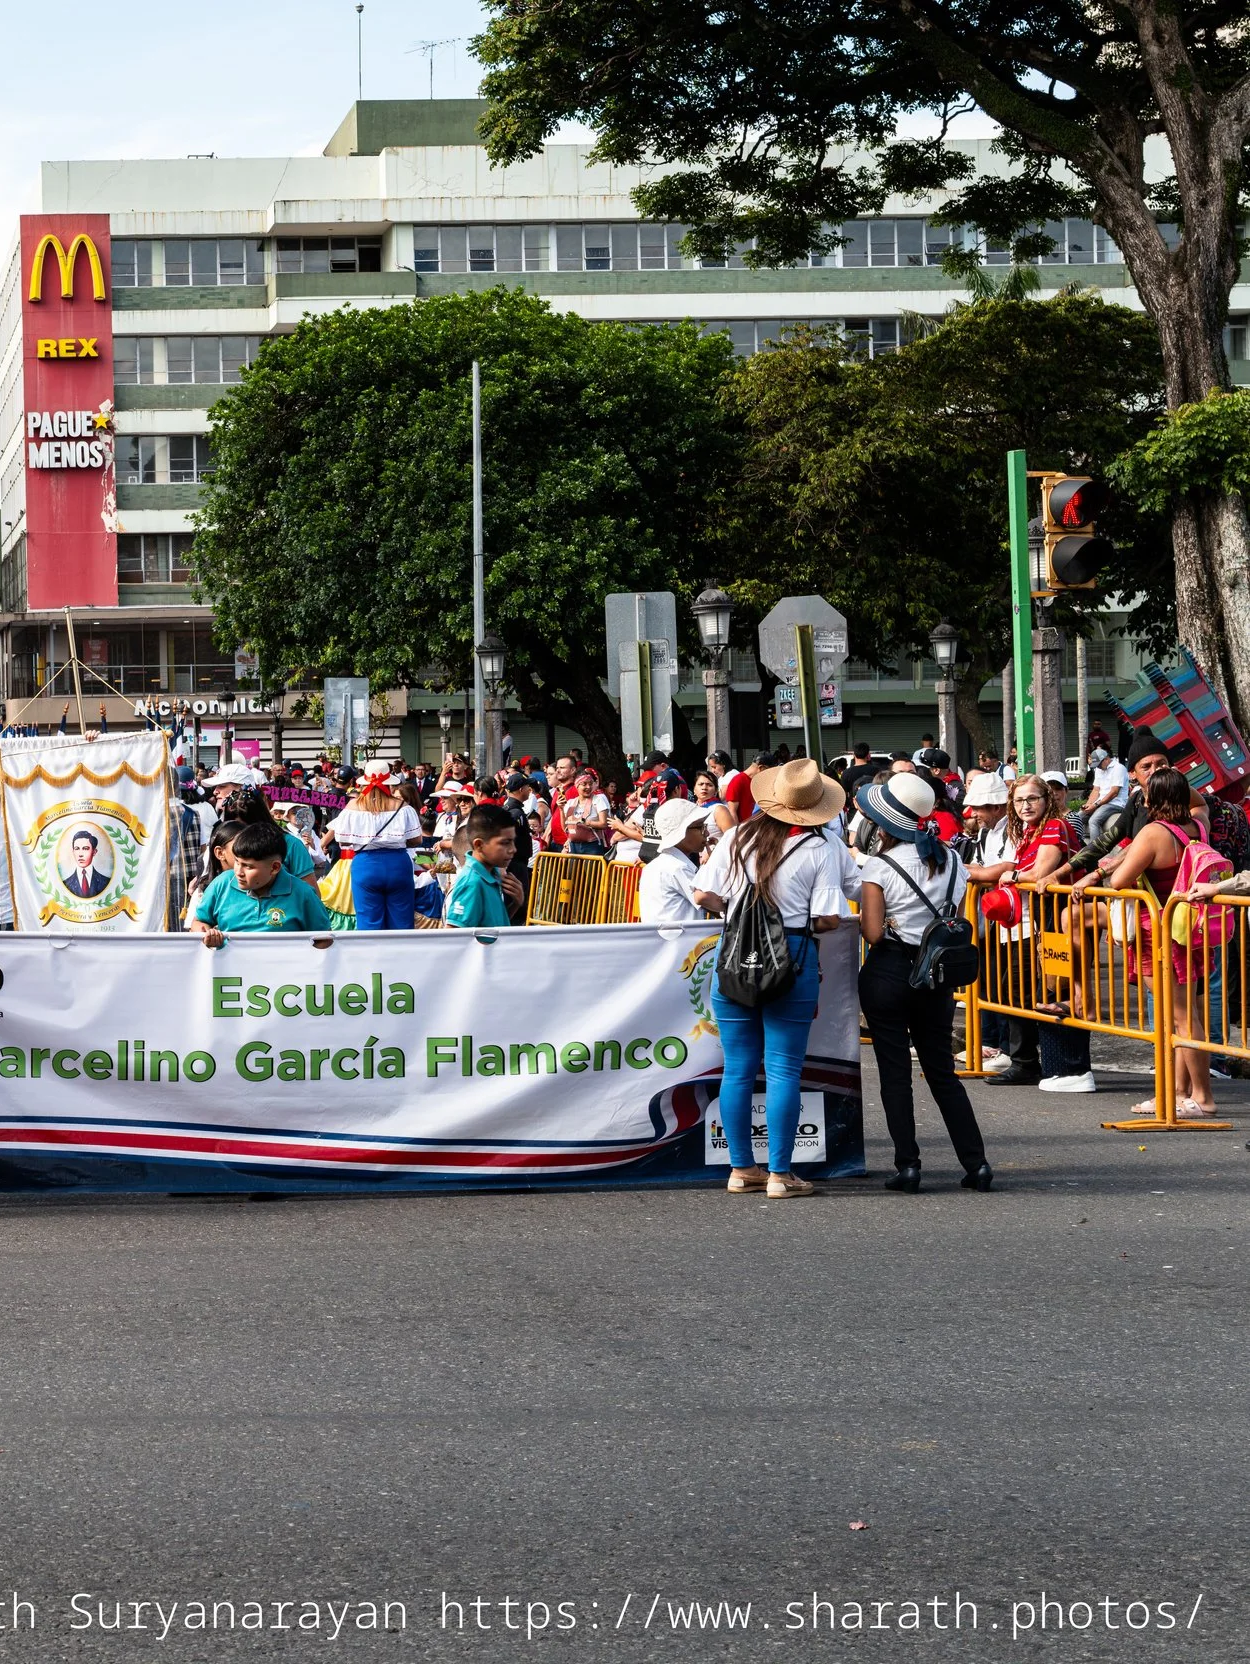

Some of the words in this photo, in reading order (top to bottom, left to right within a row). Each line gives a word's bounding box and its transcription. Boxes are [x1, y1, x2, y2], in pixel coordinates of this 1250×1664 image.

[37, 337, 99, 359] REX
[27, 411, 94, 439] PAGUE
[28, 440, 104, 470] MENOS
[212, 972, 416, 1018] Escuela
[235, 1035, 406, 1082] García
[425, 1034, 688, 1078] Flamenco
